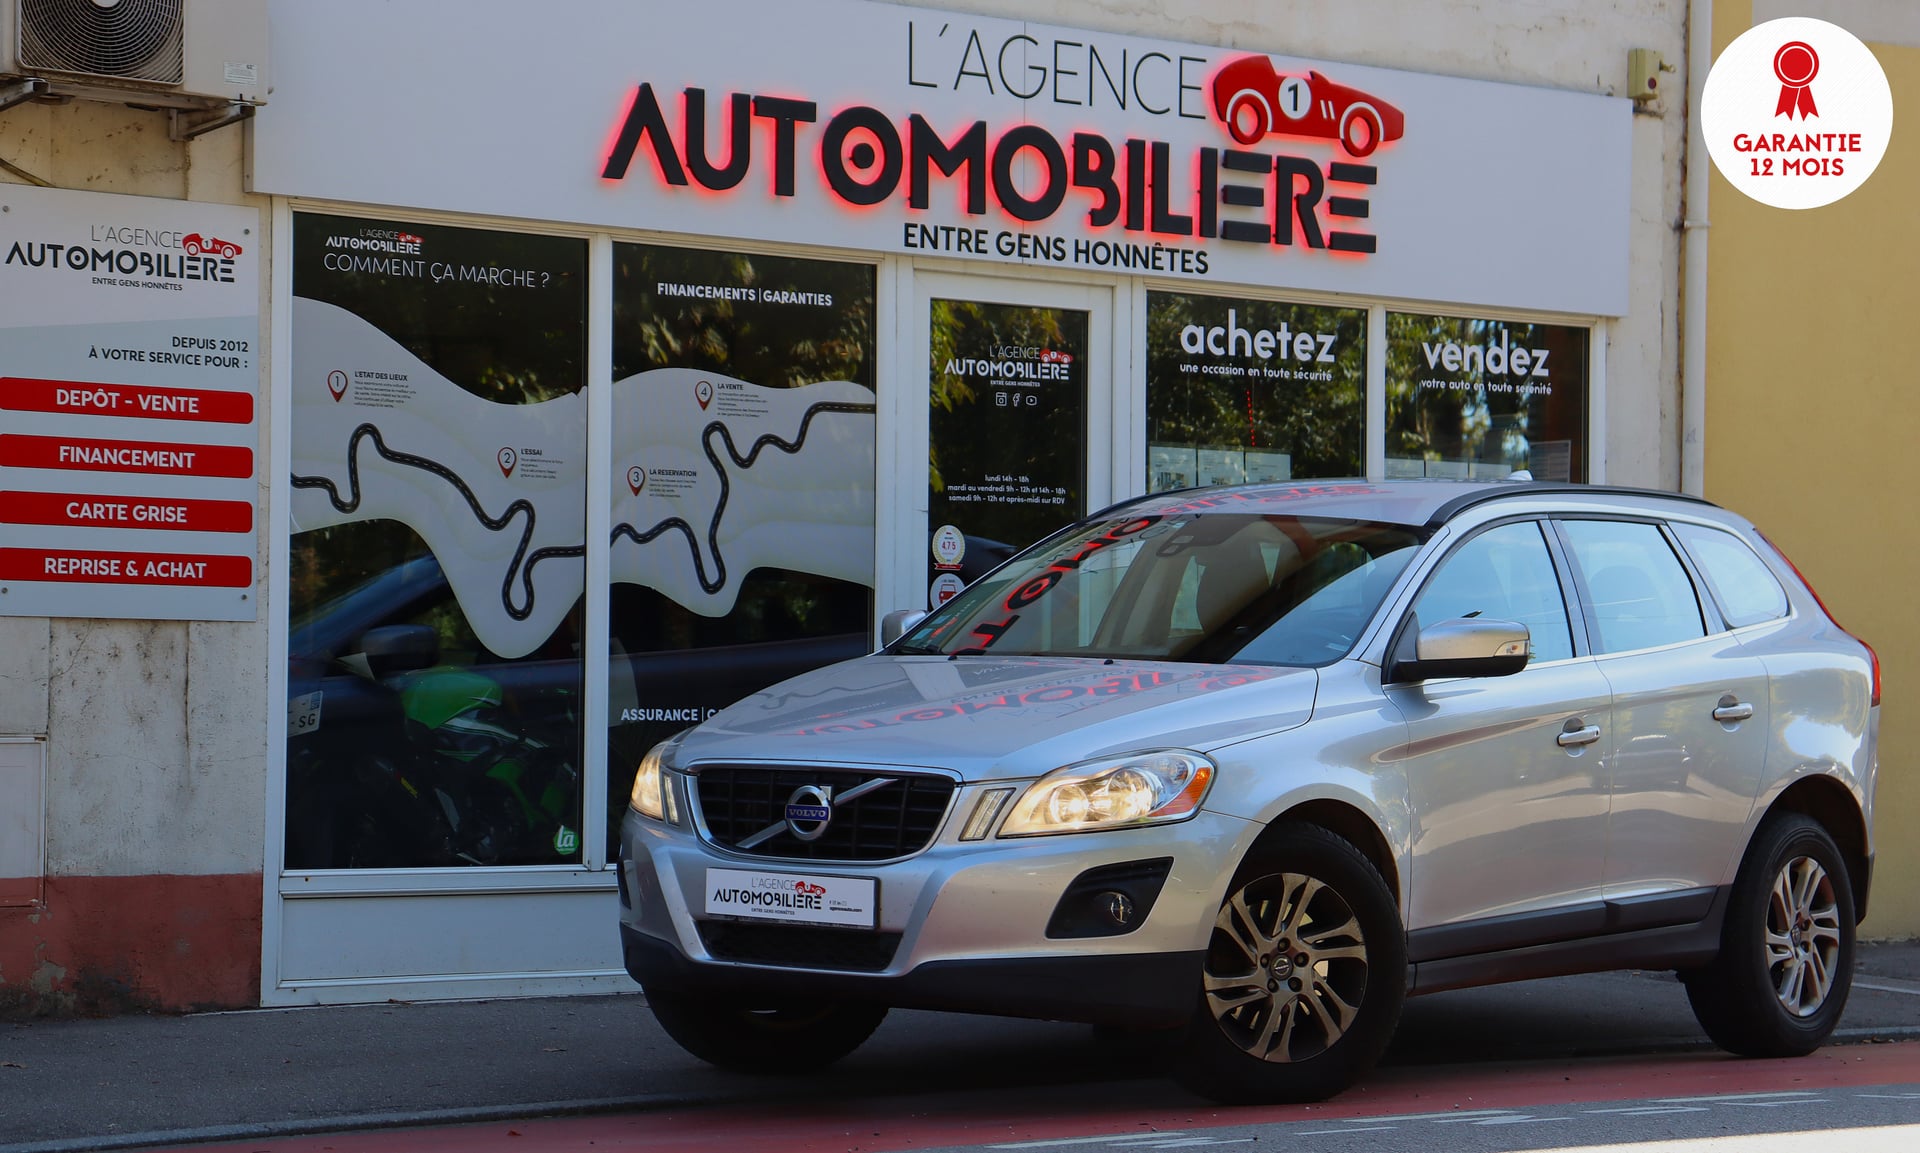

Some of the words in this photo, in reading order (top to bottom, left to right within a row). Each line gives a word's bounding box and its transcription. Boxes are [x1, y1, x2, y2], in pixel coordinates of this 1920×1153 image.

[908, 21, 1207, 119] L'AGENCE
[1288, 83, 1298, 111] 1
[91, 224, 183, 249] L'AGENCE
[360, 228, 399, 240] L'AGENCE
[904, 223, 988, 254] ENTRE
[996, 231, 1066, 261] GENS
[1074, 238, 1209, 274] HONNÊTES
[324, 253, 426, 278] COMMENT
[430, 262, 455, 283] ÇA
[460, 264, 536, 288] MARCHE
[541, 272, 550, 288] ?
[92, 277, 118, 287] ENTRE
[118, 279, 140, 288] GENS
[141, 280, 183, 291] HONNÊTES
[657, 282, 755, 301] FINANCEMENTS
[763, 290, 832, 306] GARANTIES
[1180, 308, 1335, 363] achetez
[172, 336, 216, 350] DEPUIS
[220, 340, 248, 352] 2012
[88, 345, 98, 359] À
[101, 348, 145, 361] VOTRE
[148, 352, 201, 365] SERVICE
[204, 356, 240, 368] POUR
[989, 345, 1041, 360] L'AGENCE
[1422, 329, 1550, 376] vendez
[1179, 363, 1199, 374] une
[1202, 363, 1245, 376] occasion
[1248, 367, 1260, 377] en
[1263, 366, 1290, 379] toute
[1293, 367, 1333, 381] sécurité
[335, 375, 339, 387] 1
[1421, 378, 1446, 389] votre
[1449, 380, 1470, 391] auto
[1473, 382, 1485, 391] en
[1488, 382, 1512, 393] toute
[701, 387, 707, 396] 4
[56, 388, 120, 408] DEPÔT
[138, 394, 199, 413] VENTE
[59, 446, 195, 468] FINANCEMENT
[504, 452, 511, 464] 2
[633, 471, 640, 482] 3
[985, 474, 1000, 482] lundi
[1002, 474, 1012, 482] 14h
[948, 484, 966, 492] mardi
[977, 484, 1005, 493] vendredi
[1006, 485, 1014, 493] 9h
[1039, 486, 1049, 494] 14h
[1006, 495, 1040, 504] après-midi
[1052, 496, 1065, 504] RDV
[66, 502, 128, 521] CARTE
[132, 505, 188, 523] GRISE
[44, 557, 121, 576] REPRISE
[125, 560, 139, 576] &
[143, 561, 207, 578] ACHAT
[621, 708, 698, 721] ASSURANCE
[789, 808, 826, 818] VOLVO
[752, 877, 796, 891] L'AGENCE
